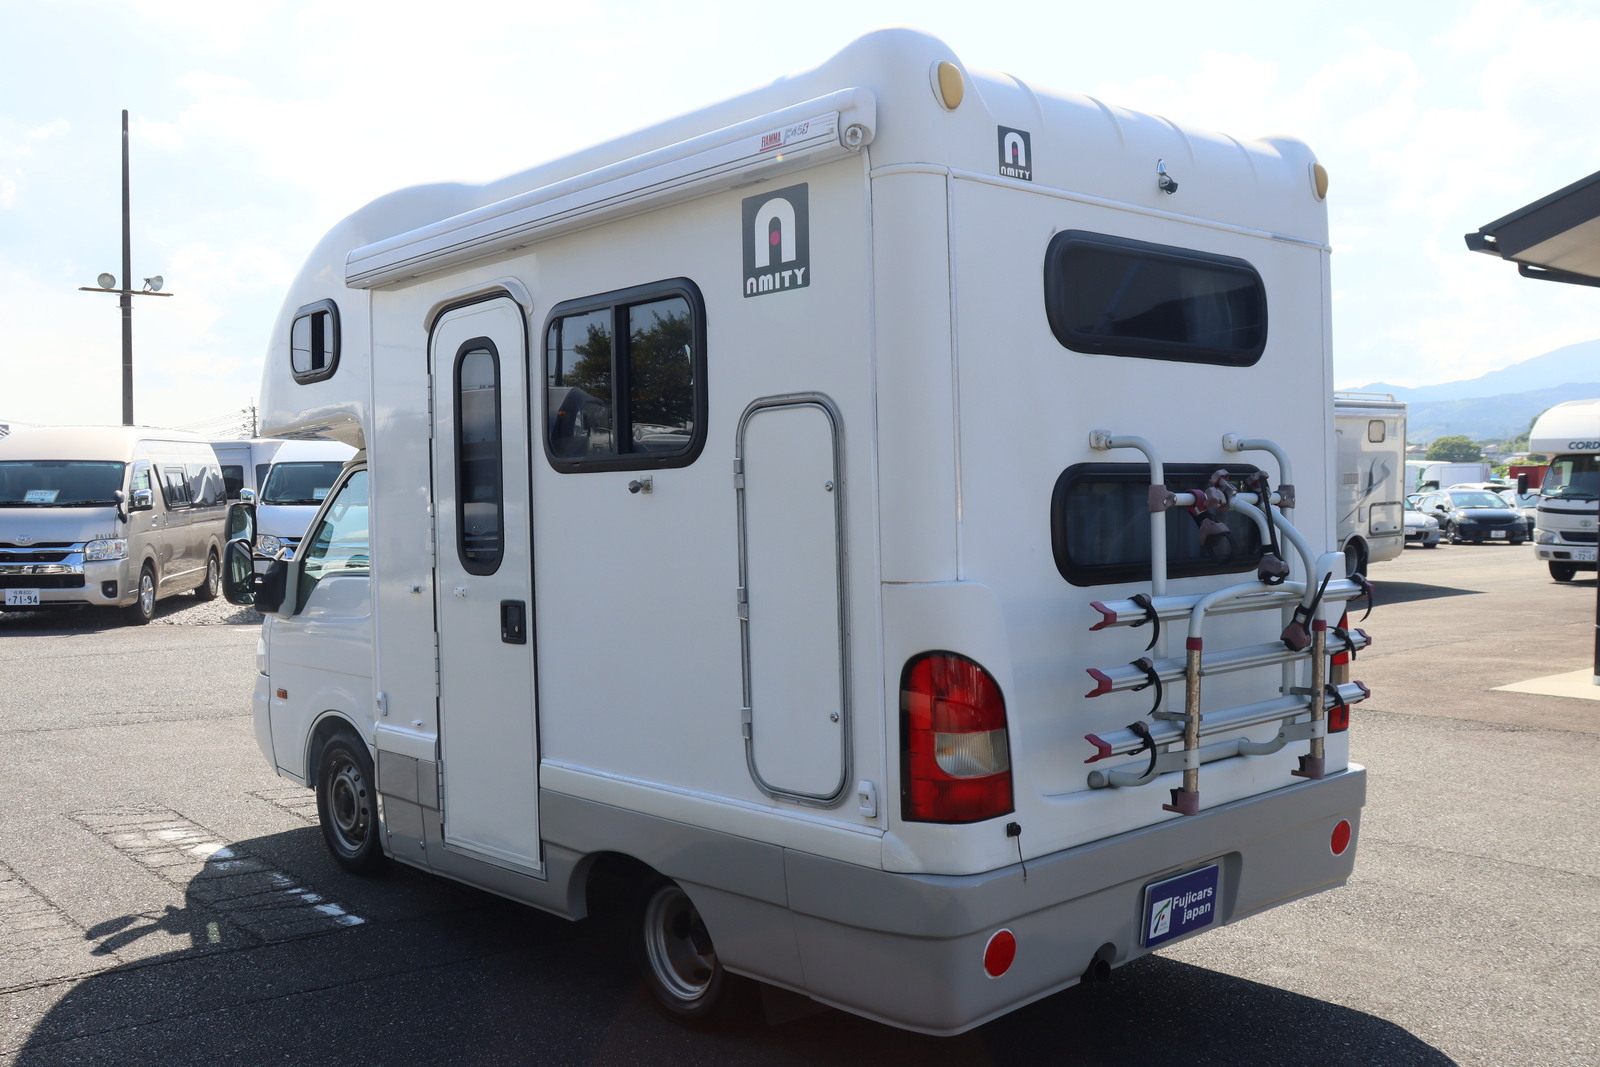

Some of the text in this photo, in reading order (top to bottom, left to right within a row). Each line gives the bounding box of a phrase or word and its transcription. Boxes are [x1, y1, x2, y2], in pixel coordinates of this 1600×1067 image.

[761, 131, 781, 148] FIAMMA
[746, 267, 806, 295] AMITY
[1172, 886, 1213, 910] Fujicars
[1182, 902, 1211, 925] japan
